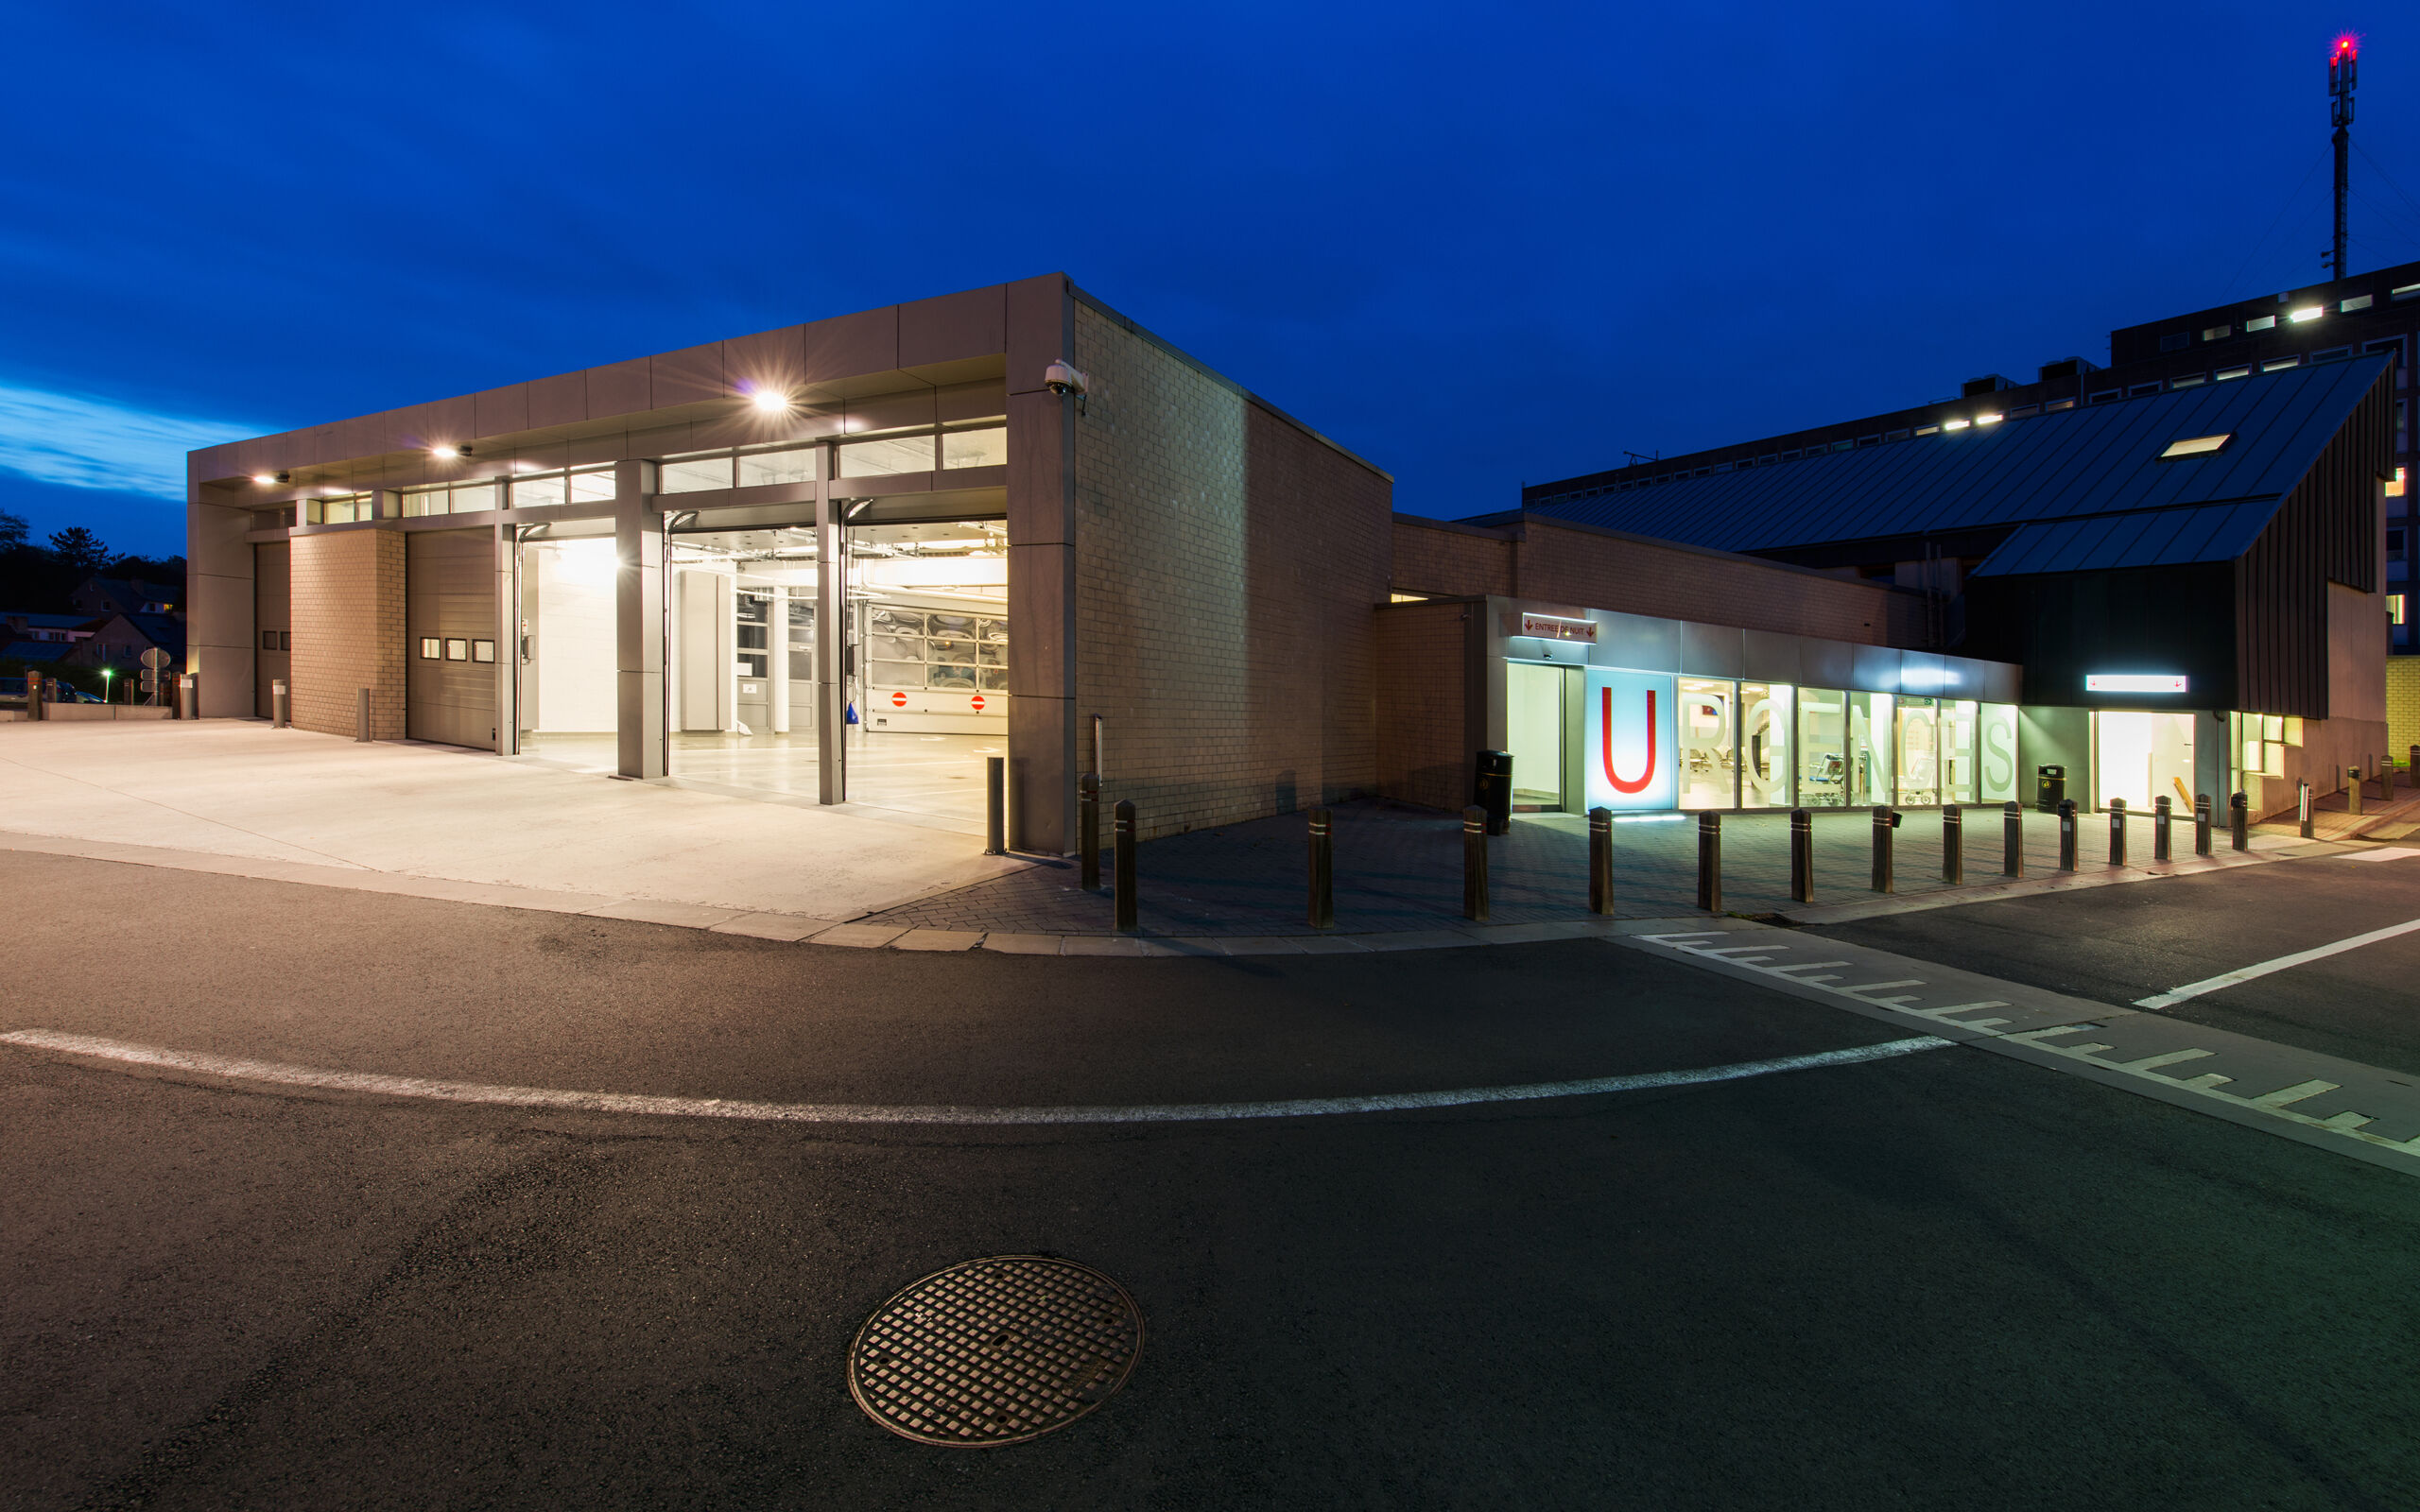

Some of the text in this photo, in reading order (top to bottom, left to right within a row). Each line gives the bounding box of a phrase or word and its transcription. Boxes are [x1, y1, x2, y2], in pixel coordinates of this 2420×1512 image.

[1535, 623, 1584, 635] ENTREE DE NUIT
[1601, 686, 2013, 795] URGENCES
